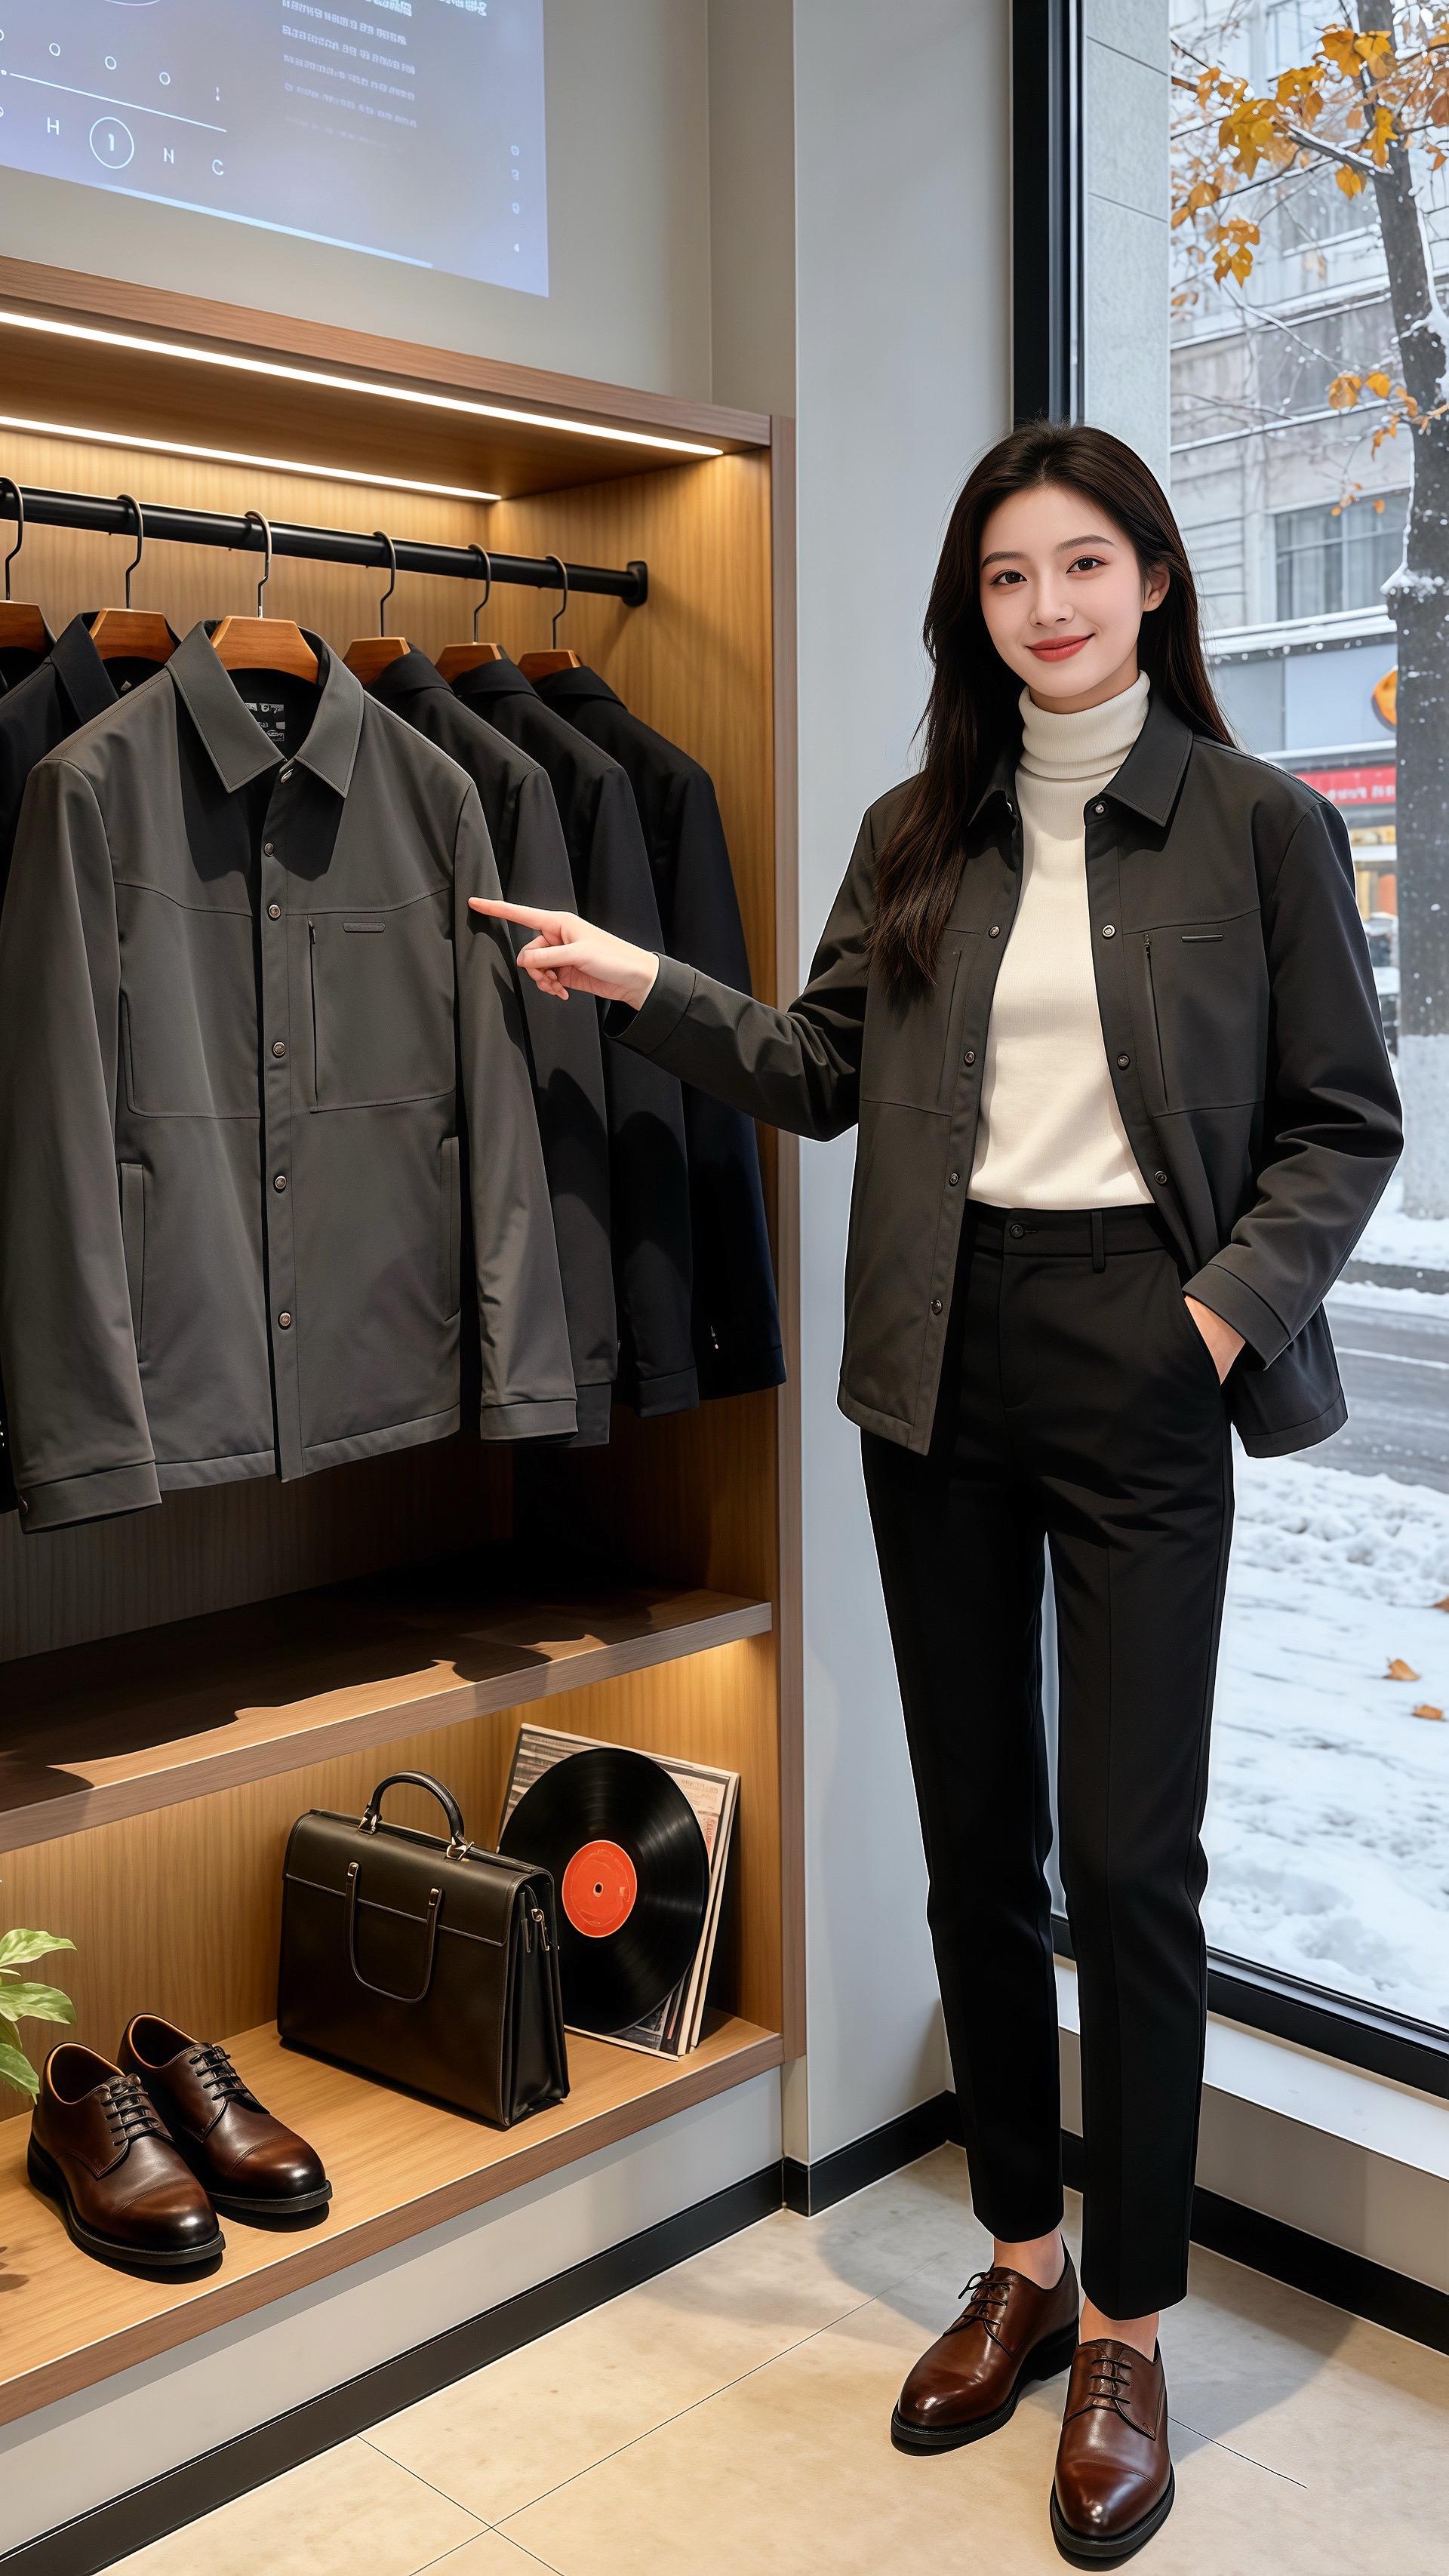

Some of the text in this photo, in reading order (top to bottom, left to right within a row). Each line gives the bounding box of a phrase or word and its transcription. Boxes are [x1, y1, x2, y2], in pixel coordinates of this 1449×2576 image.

[47, 117, 60, 135] H
[164, 147, 174, 164] N
[212, 159, 224, 176] C
